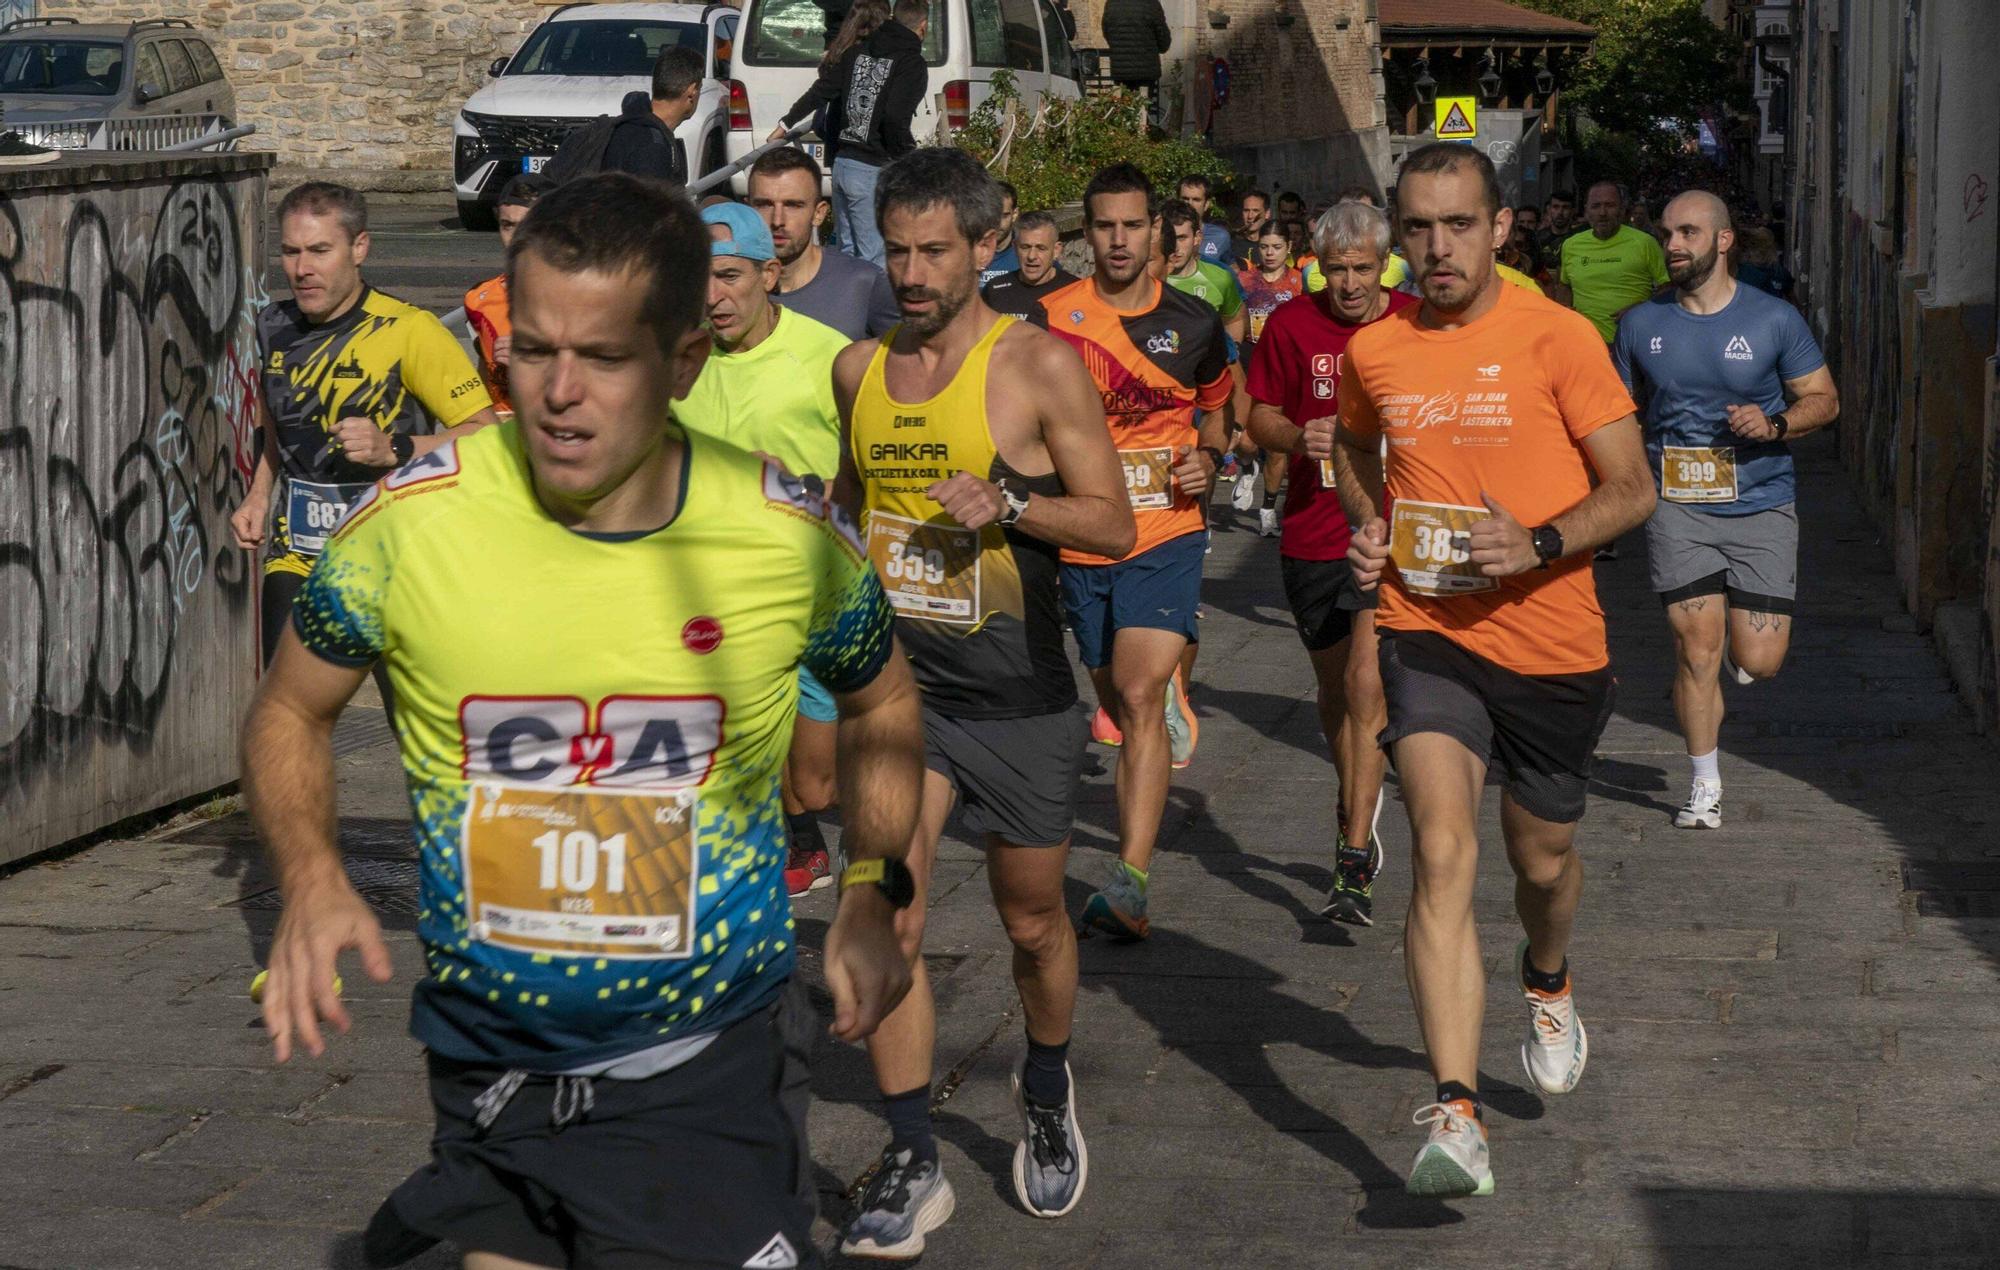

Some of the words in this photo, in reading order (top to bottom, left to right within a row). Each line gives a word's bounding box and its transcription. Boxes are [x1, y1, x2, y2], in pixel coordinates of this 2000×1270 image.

[1724, 352, 1753, 361] MADEN
[450, 377, 481, 400] 42195
[1464, 393, 1482, 403] SAN
[1483, 392, 1508, 403] JUAN
[1460, 416, 1513, 427] LASTERKETA
[870, 443, 948, 461] GAIKAR
[1678, 461, 1716, 482] 399
[1414, 526, 1472, 564] 385
[886, 541, 945, 585] 359
[532, 829, 628, 894] 101
